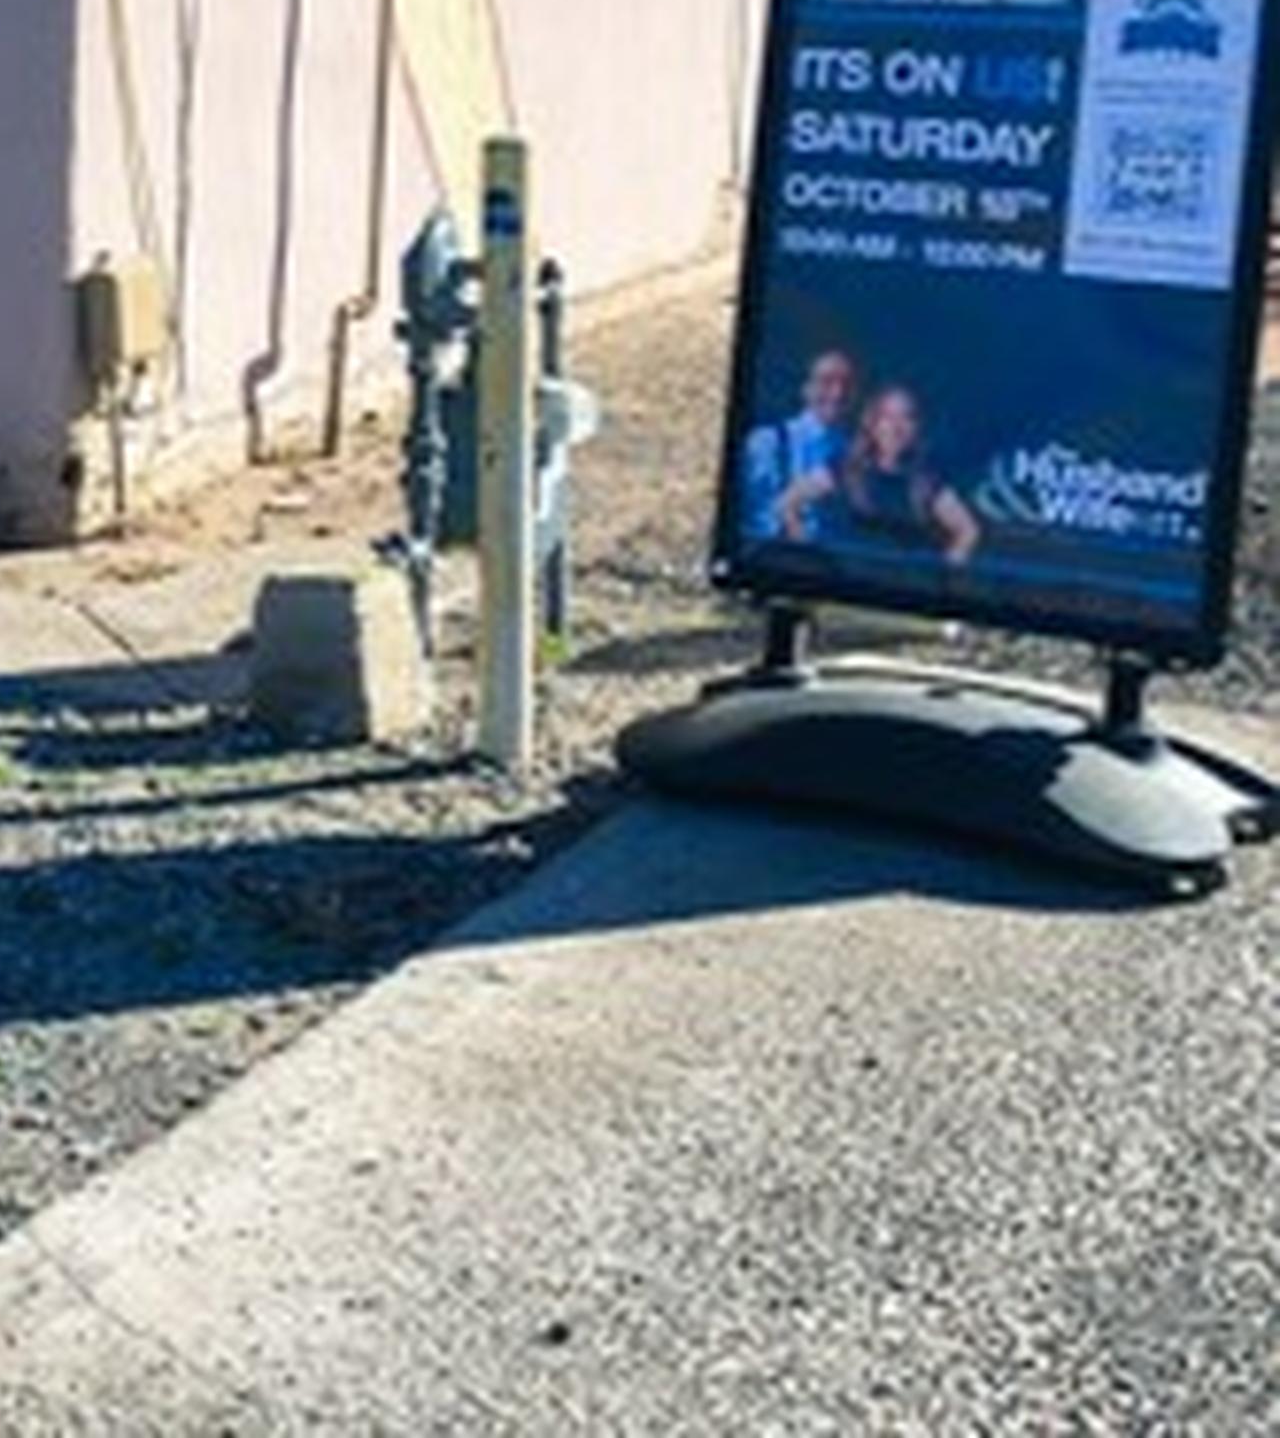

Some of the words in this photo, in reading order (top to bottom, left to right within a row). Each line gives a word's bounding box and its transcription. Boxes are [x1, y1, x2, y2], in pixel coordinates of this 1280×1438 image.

[791, 49, 870, 92] ITS
[883, 50, 961, 97] ON
[789, 111, 1053, 166] SATURDAY
[783, 173, 968, 217] OCTOBER
[1015, 448, 1208, 507] Husband
